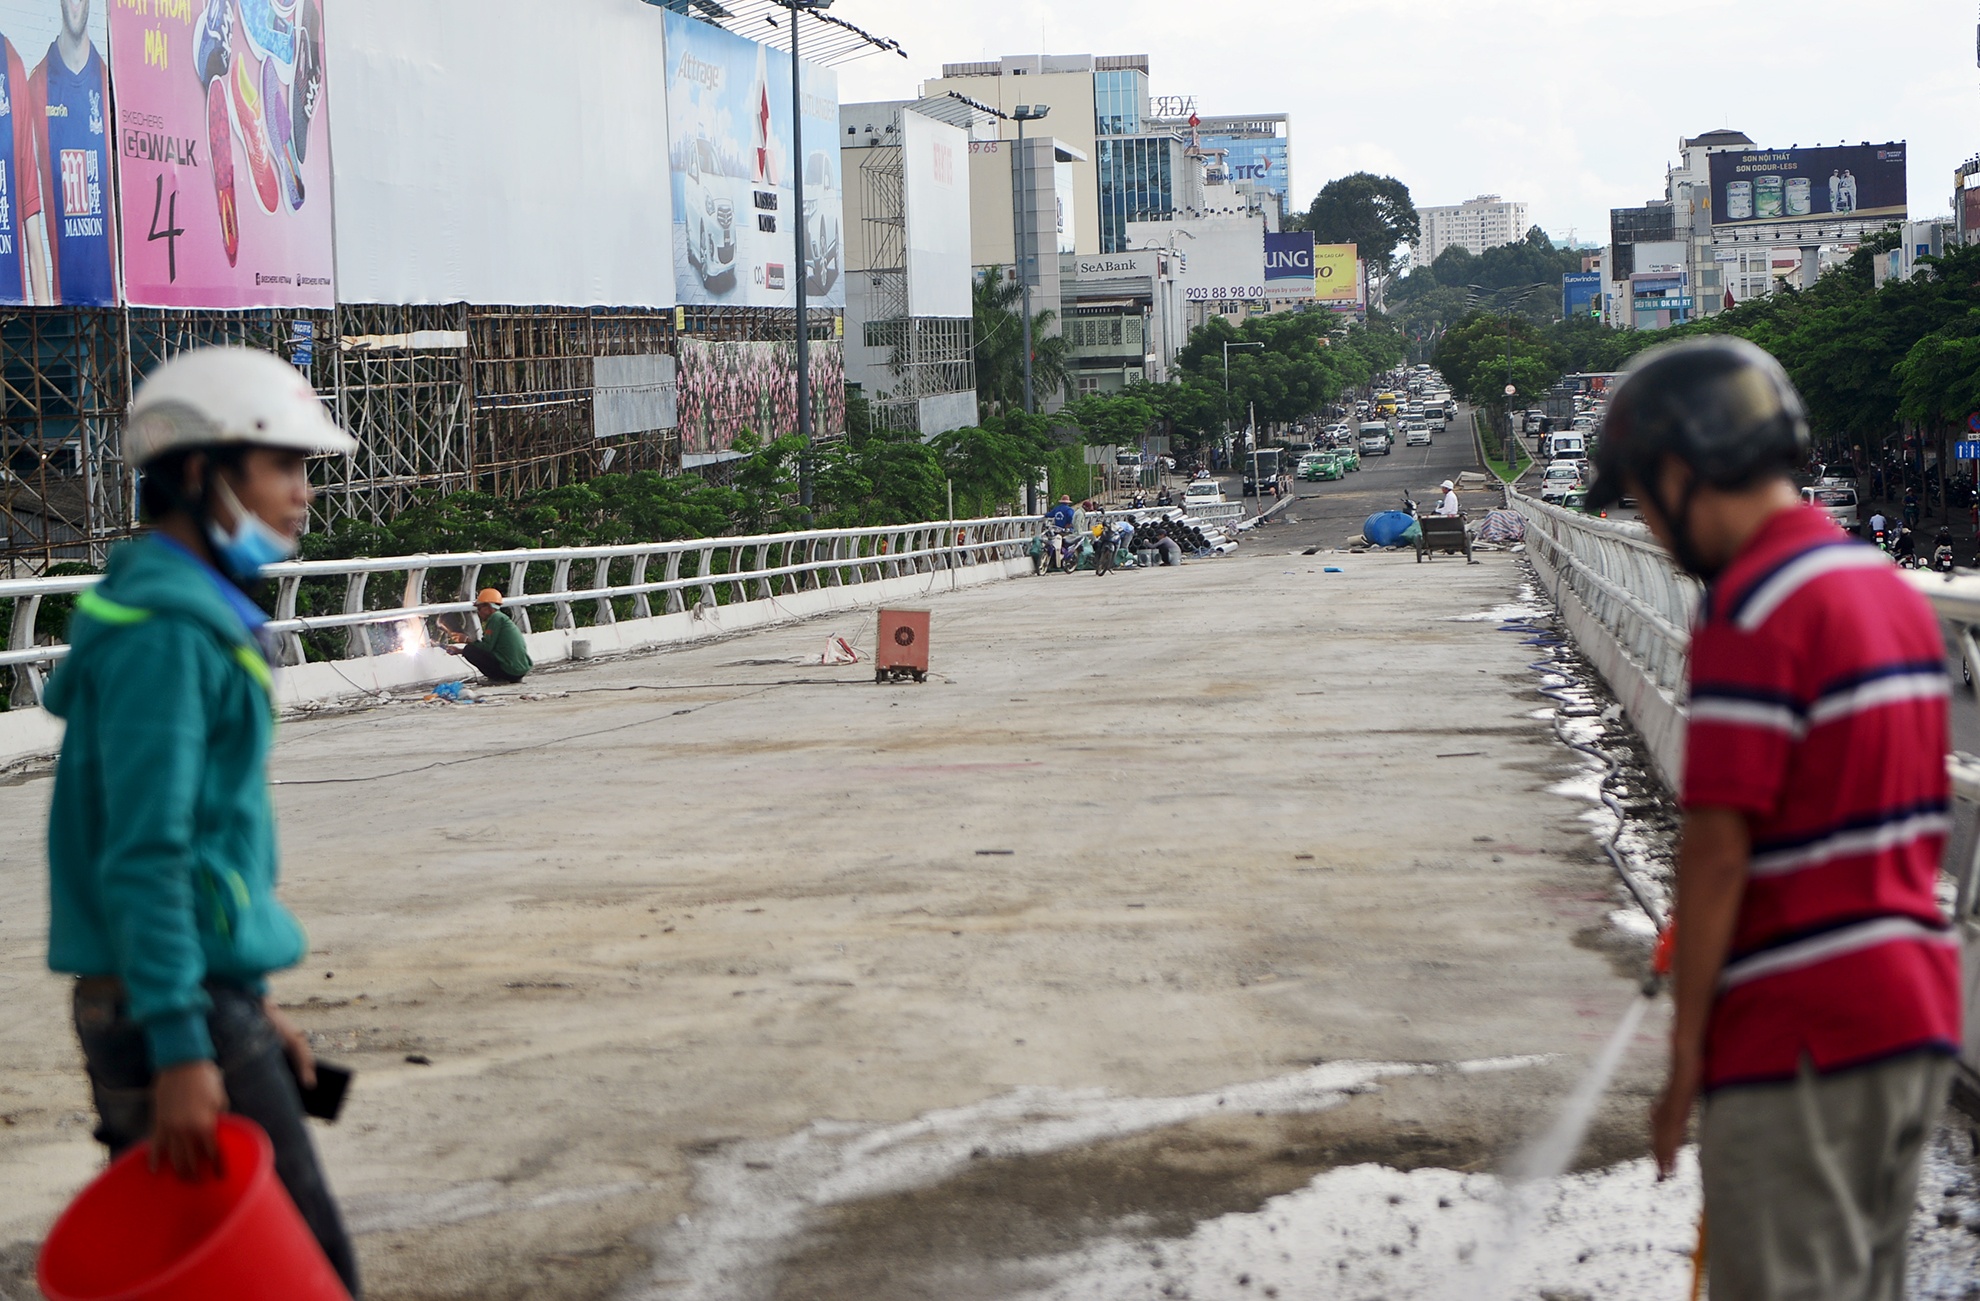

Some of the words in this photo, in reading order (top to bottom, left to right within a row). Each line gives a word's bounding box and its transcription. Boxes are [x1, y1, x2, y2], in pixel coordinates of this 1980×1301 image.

[678, 51, 720, 91] Attrage
[122, 109, 164, 130] SKECHERS
[983, 142, 998, 153] 65
[1758, 153, 1771, 163] NỘI
[1235, 164, 1265, 179] TTC
[1752, 162, 1798, 172] ODOUR-LESS
[64, 217, 103, 238] MANSION
[148, 173, 185, 285] 4
[1081, 259, 1137, 273] SeABank
[1264, 250, 1309, 268] UNG
[1186, 288, 1208, 299] 903
[1212, 287, 1227, 299] 88
[1230, 286, 1245, 298] 98
[1248, 285, 1263, 297] 00
[1661, 299, 1670, 307] OK
